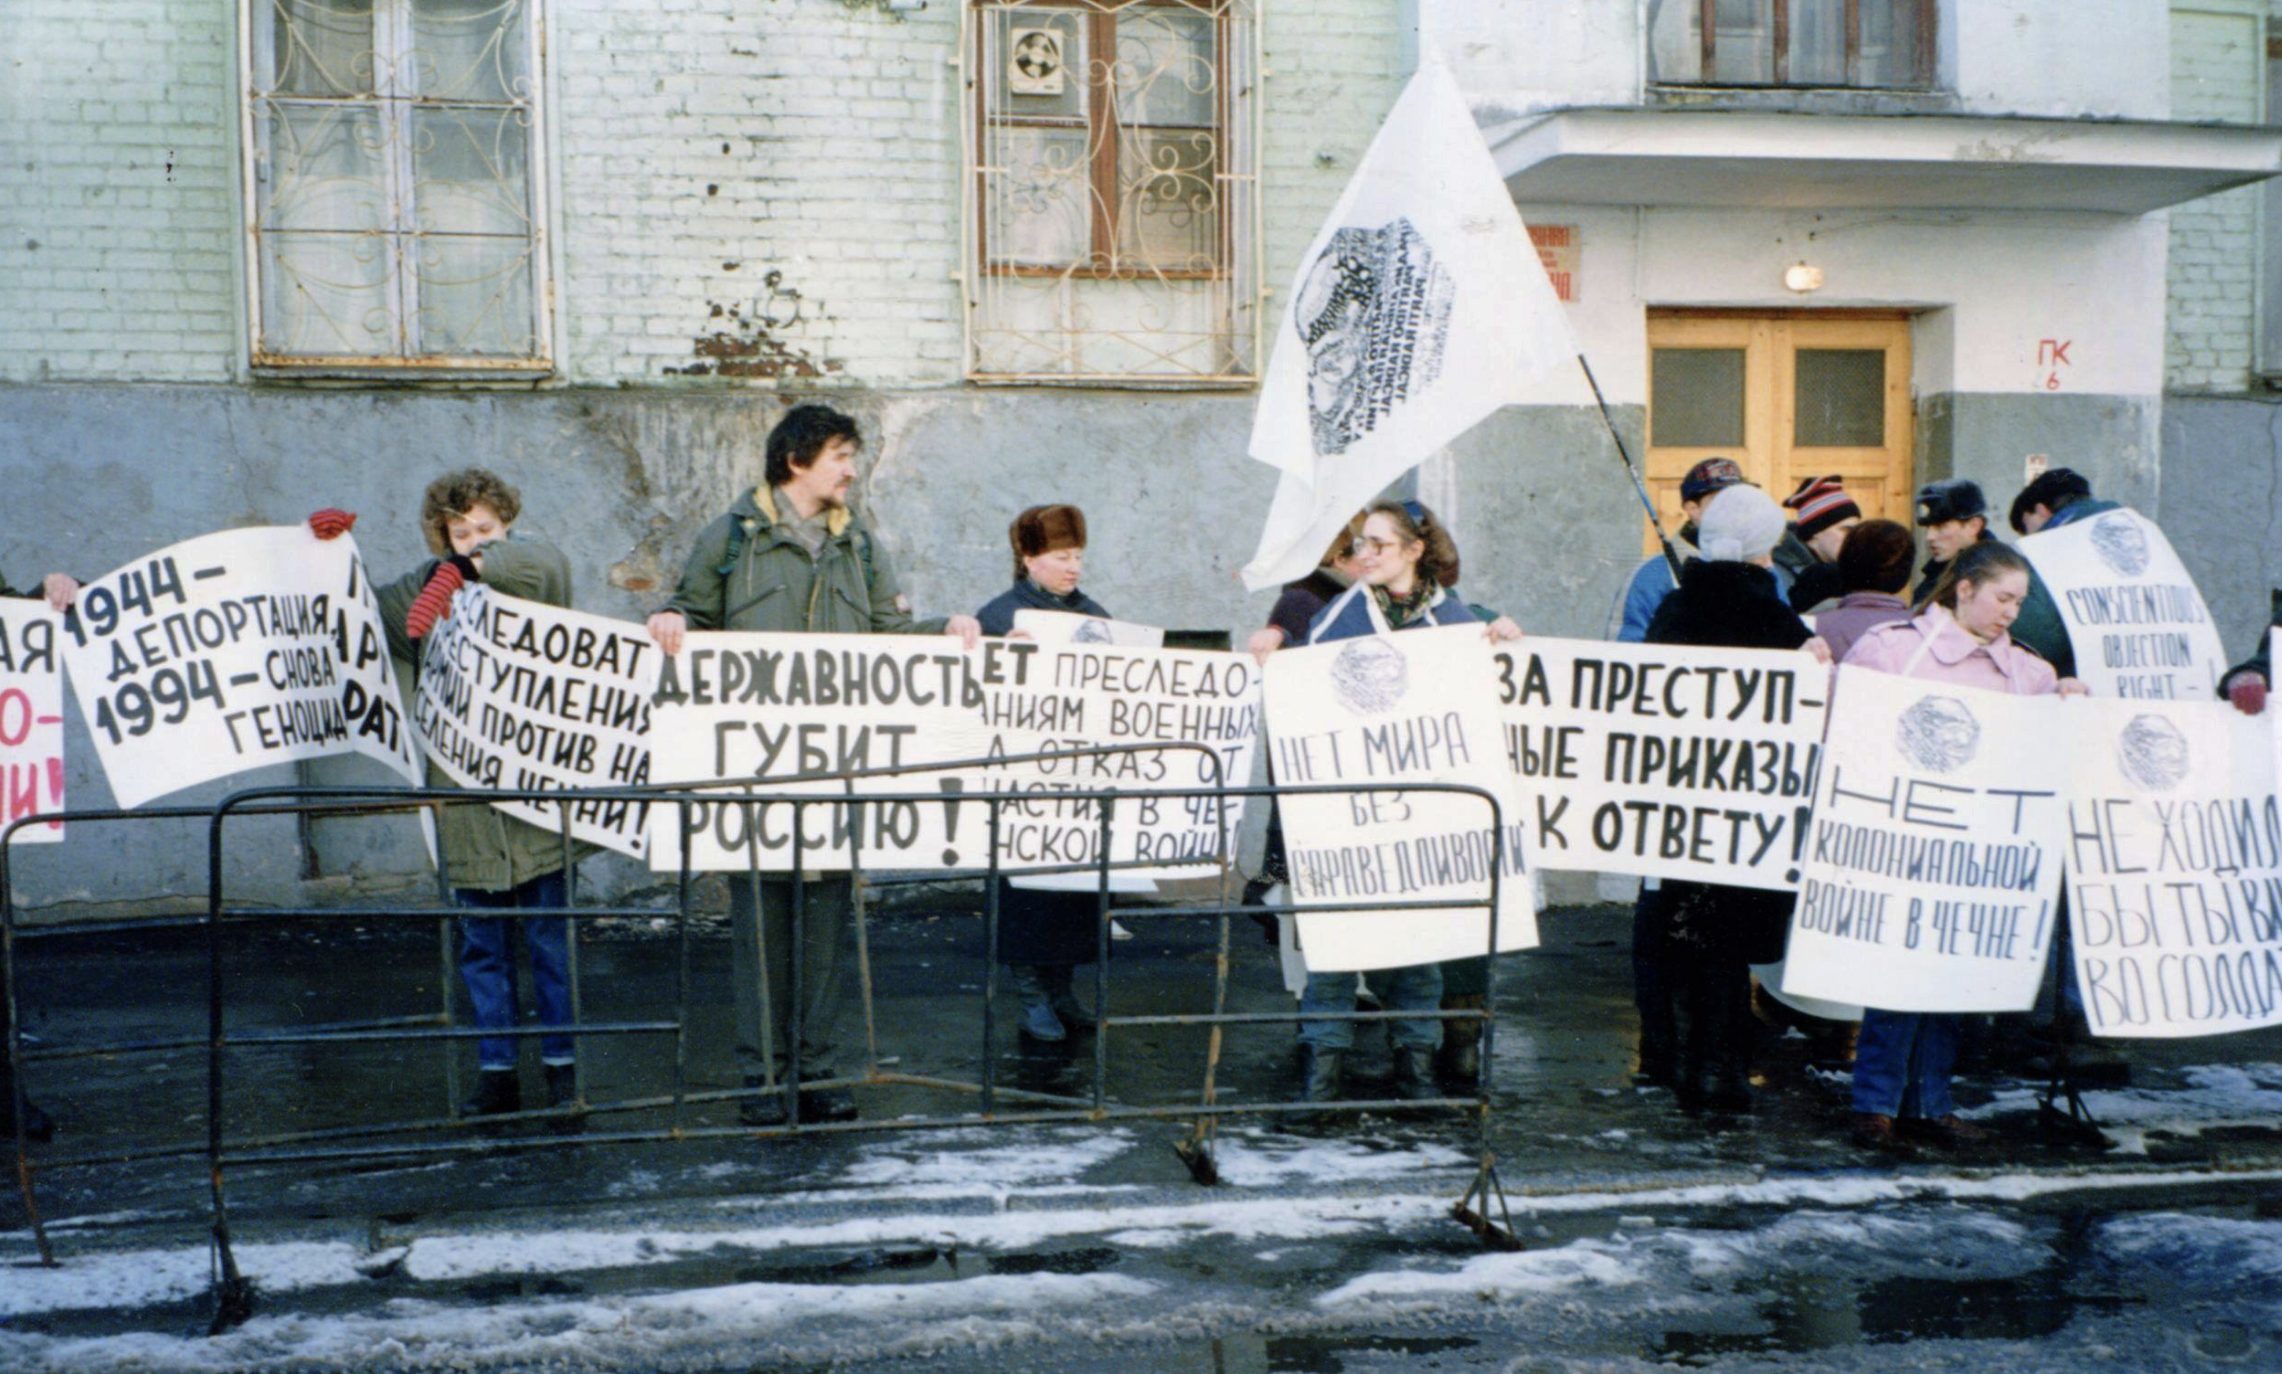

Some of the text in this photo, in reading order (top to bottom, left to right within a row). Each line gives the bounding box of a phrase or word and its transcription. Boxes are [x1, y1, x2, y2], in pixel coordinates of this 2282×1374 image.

[2037, 339, 2072, 366] ПК
[65, 557, 187, 647] 1944
[651, 647, 985, 708] ДЕРЖАВНОСТЬ
[1494, 653, 1551, 707] ЗА
[2103, 631, 2193, 668] OBJECTION
[97, 659, 225, 744] 1994
[265, 646, 335, 691] СНОВА
[2116, 674, 2175, 700] RIGHT
[225, 697, 347, 754] ГЕНОЦИД
[481, 702, 597, 774] ПРОТИВ
[715, 721, 917, 777] ГУБИТ
[1110, 698, 1259, 741] ВОЕННЫХ
[1279, 711, 1470, 783] НЕТ МИРА
[1037, 738, 1166, 782] ОТКАЗ
[1605, 732, 1819, 798] ПРИКАЗЫ
[1139, 790, 1160, 826] В
[1349, 790, 1411, 827] БЕЗ
[1830, 765, 2056, 835] НЕТ
[1537, 794, 1811, 884] К ОТВЕТУ!
[2069, 798, 2148, 875] НЕ
[1800, 878, 1894, 946] ВОЙНЕ
[1905, 897, 1923, 950] В
[2084, 947, 2282, 1027] ВО СОЛДА
